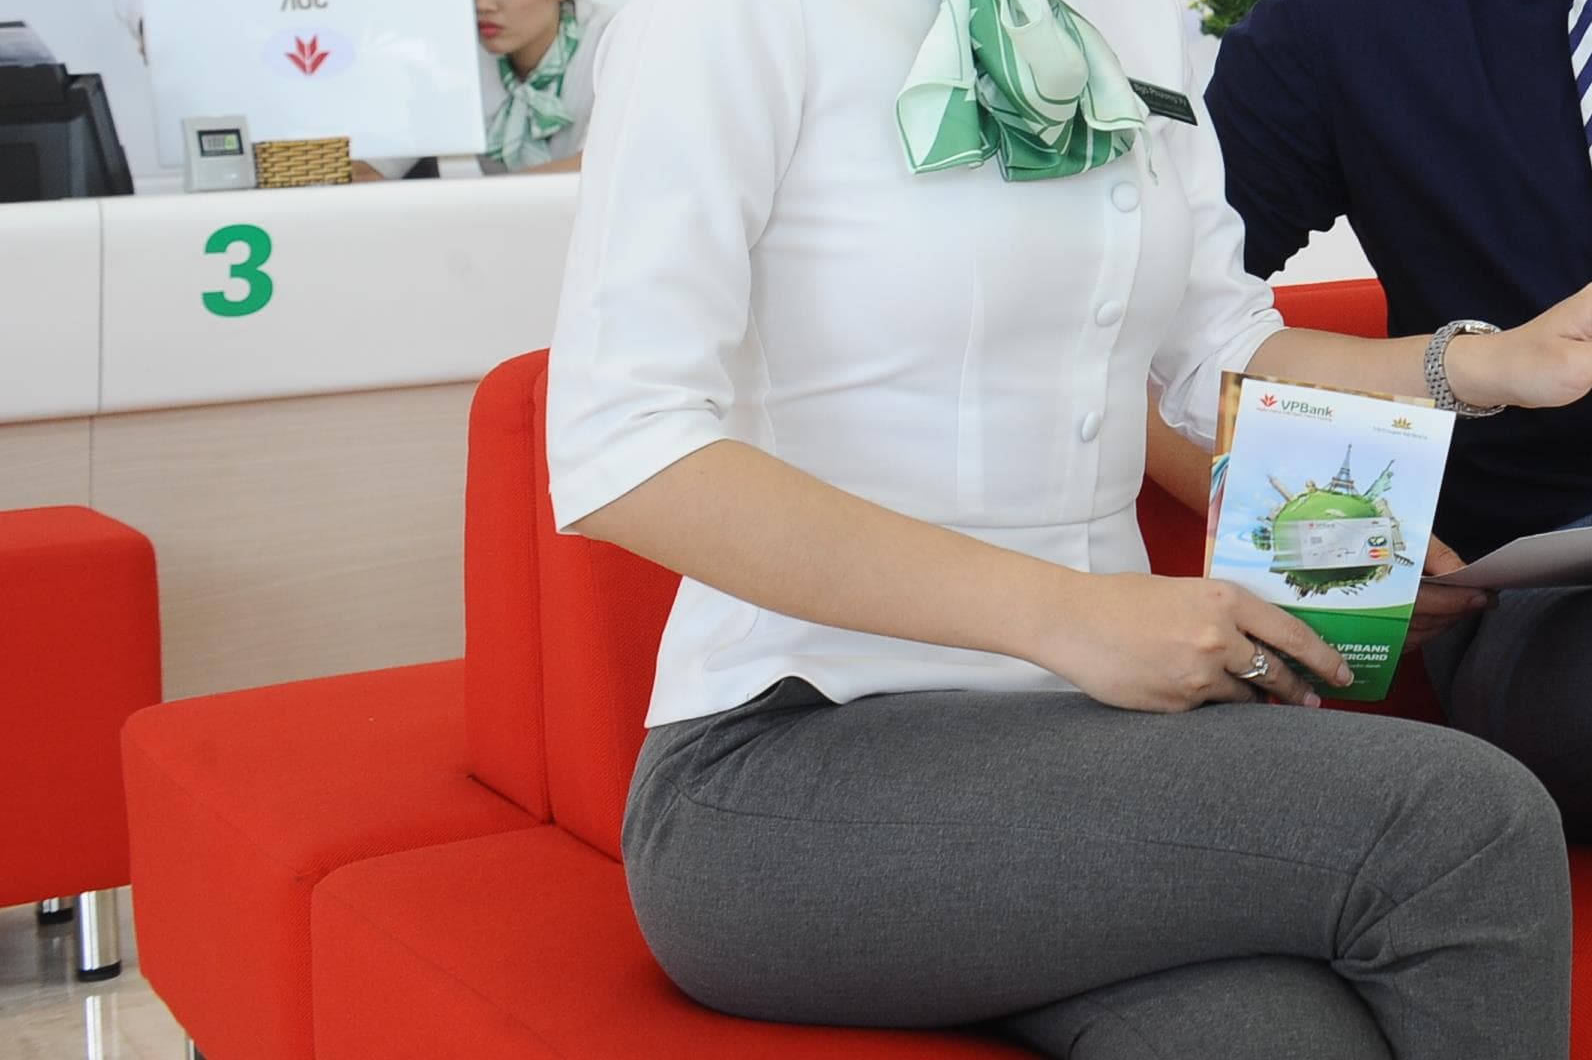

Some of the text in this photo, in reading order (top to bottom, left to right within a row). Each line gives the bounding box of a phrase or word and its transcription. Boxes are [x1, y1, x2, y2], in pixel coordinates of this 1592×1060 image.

[202, 223, 273, 317] 3
[1281, 400, 1333, 418] VPBank
[1337, 643, 1391, 653] VPBANK
[1341, 653, 1388, 661] ERCARD
